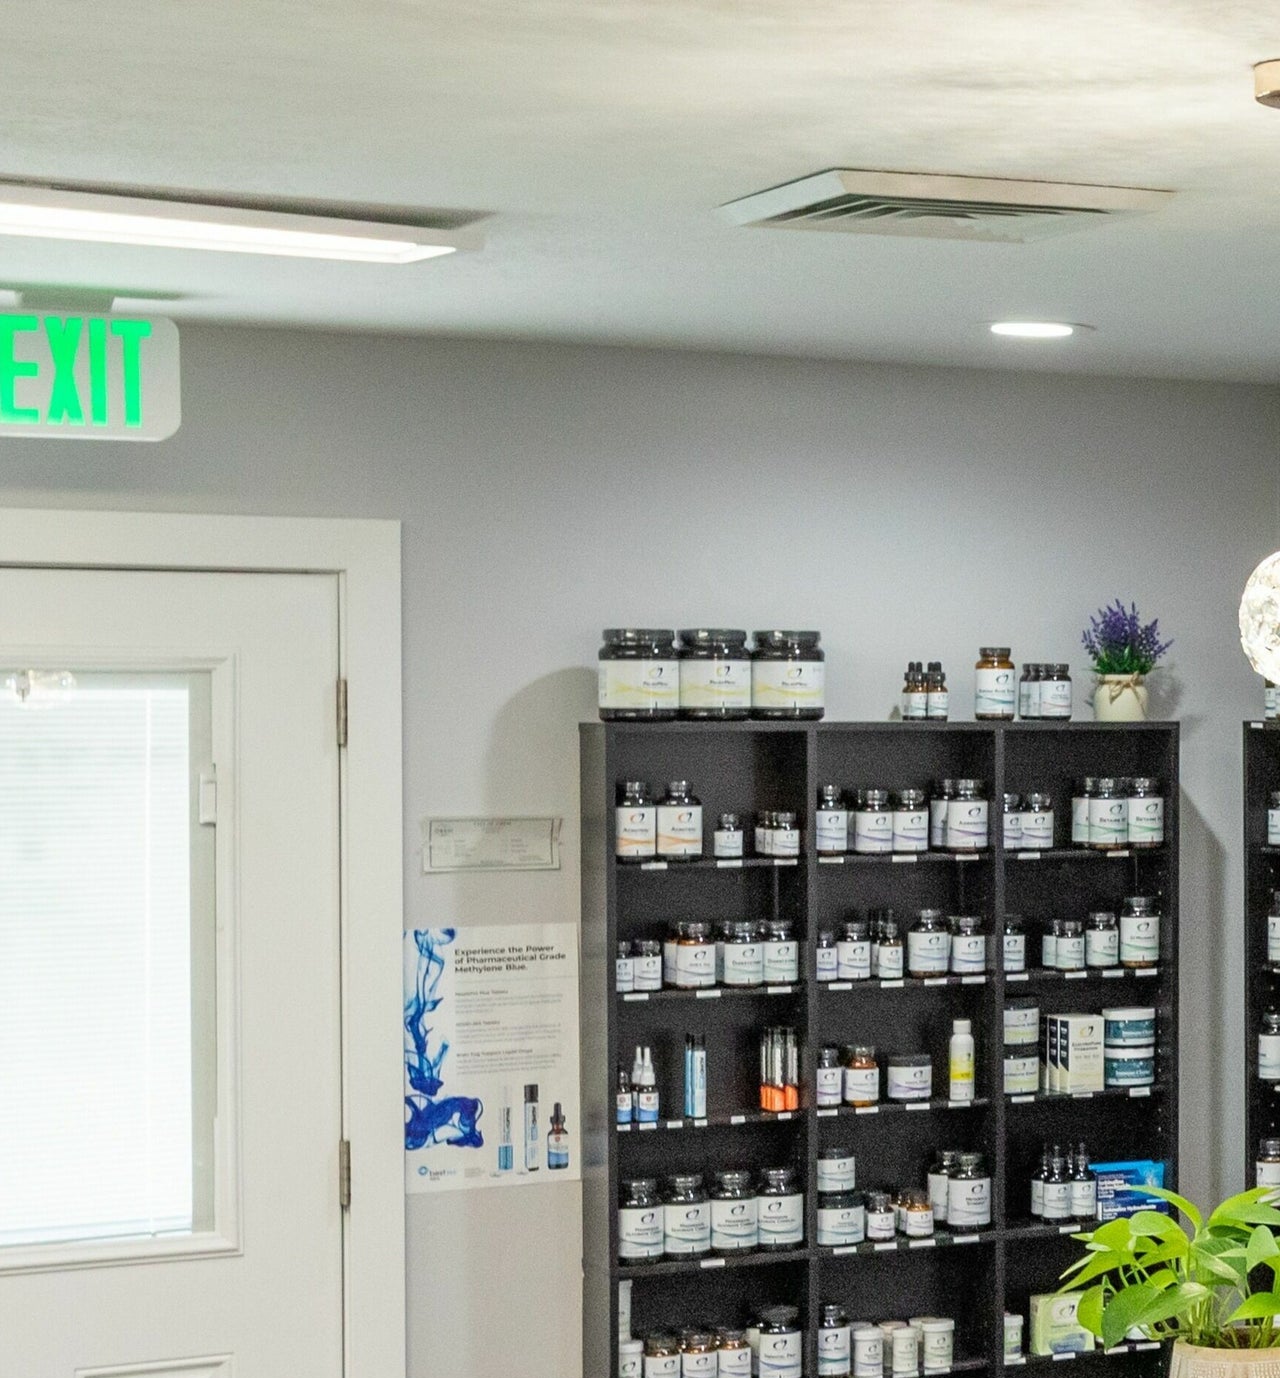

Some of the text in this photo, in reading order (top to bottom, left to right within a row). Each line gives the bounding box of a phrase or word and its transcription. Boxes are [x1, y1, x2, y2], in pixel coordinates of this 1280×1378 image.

[0, 314, 151, 428] EXIT
[455, 944, 554, 956] Experience the Power
[455, 952, 566, 965] of Pharmaceutical Grade
[455, 964, 502, 974] Methylene
